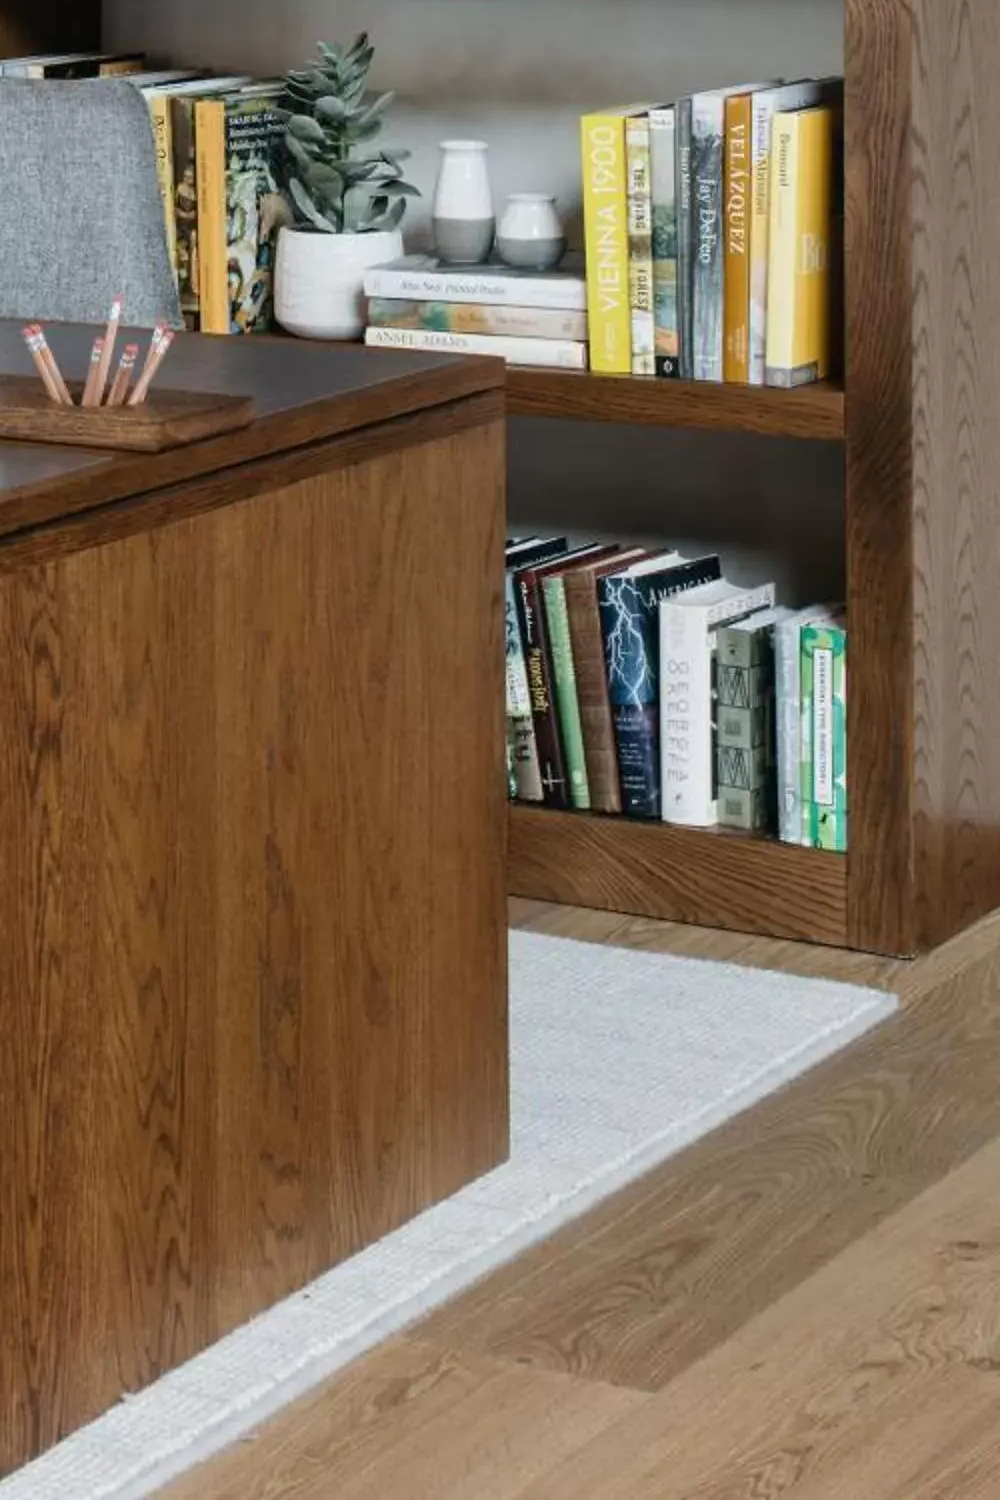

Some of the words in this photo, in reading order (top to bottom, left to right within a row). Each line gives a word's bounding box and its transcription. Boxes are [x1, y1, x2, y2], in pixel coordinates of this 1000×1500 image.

[592, 124, 618, 195] 1900
[695, 178, 718, 204] Jay
[729, 122, 750, 256] VELÁZQUEZ
[596, 202, 621, 315] VIENNA
[698, 207, 717, 265] DeFeo
[374, 330, 419, 346] ANSEL
[423, 333, 471, 347] ADAMS
